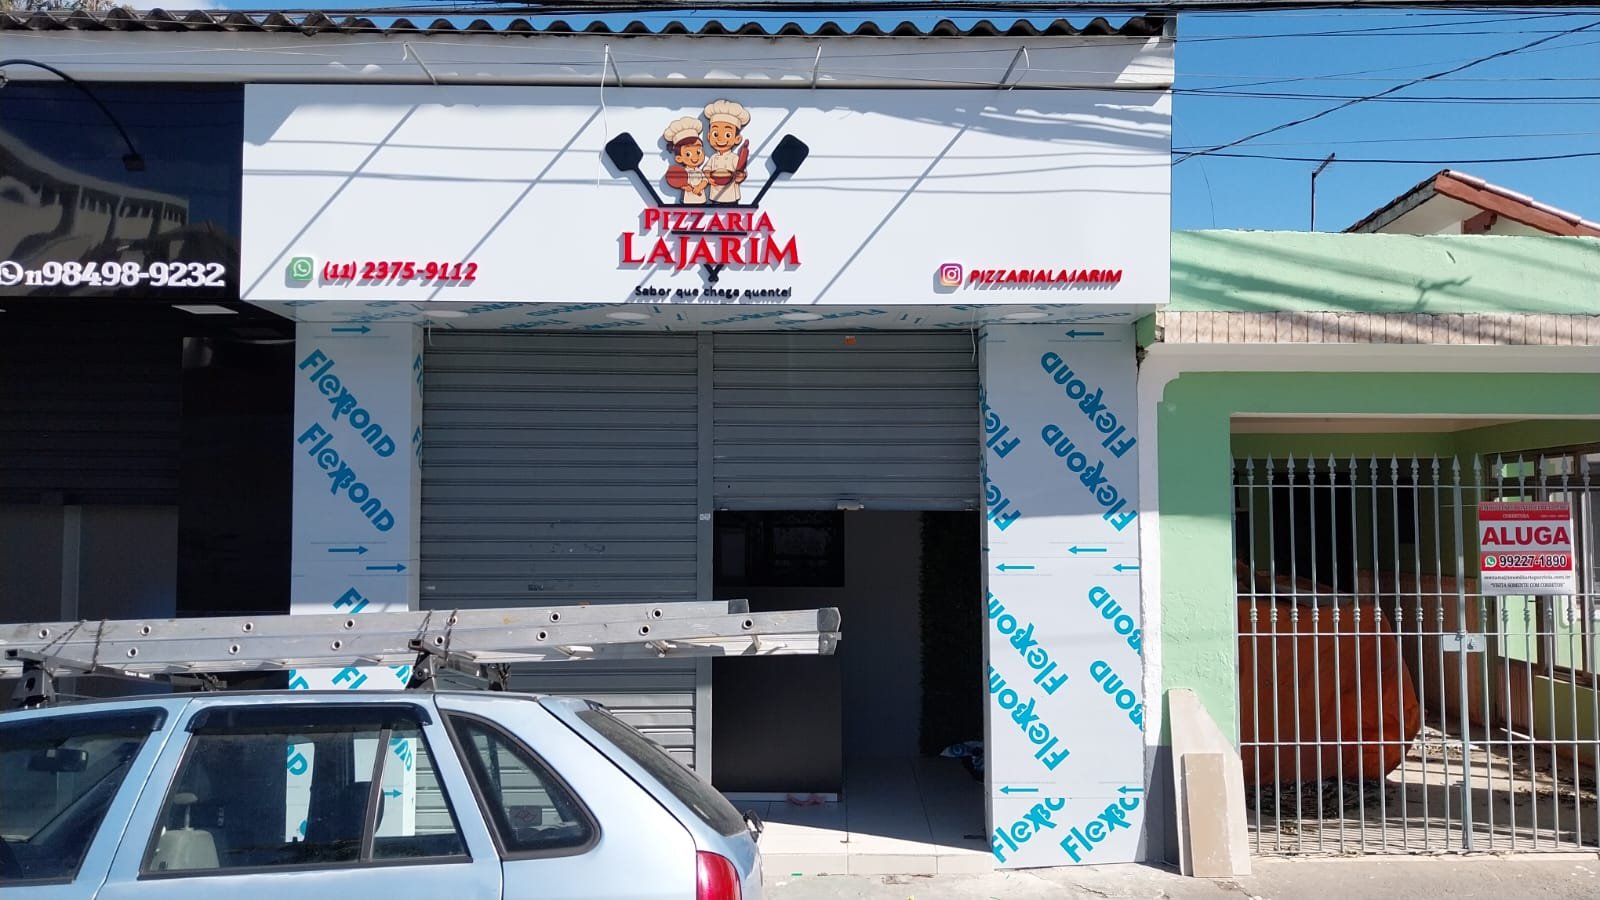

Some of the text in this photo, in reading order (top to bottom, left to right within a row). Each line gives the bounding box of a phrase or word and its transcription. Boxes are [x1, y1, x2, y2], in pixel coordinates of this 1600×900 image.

[643, 207, 776, 232] PIZZARIA
[621, 231, 801, 271] LAJARIM
[323, 261, 478, 281] (11) 2375-9112
[968, 269, 1123, 284] PIZZARIALAJARIM
[634, 285, 672, 297] Sabor
[675, 287, 699, 299] que
[703, 286, 740, 300] chega
[1481, 526, 1571, 546] ALUGA
[1499, 554, 1567, 568] 99227-1890
